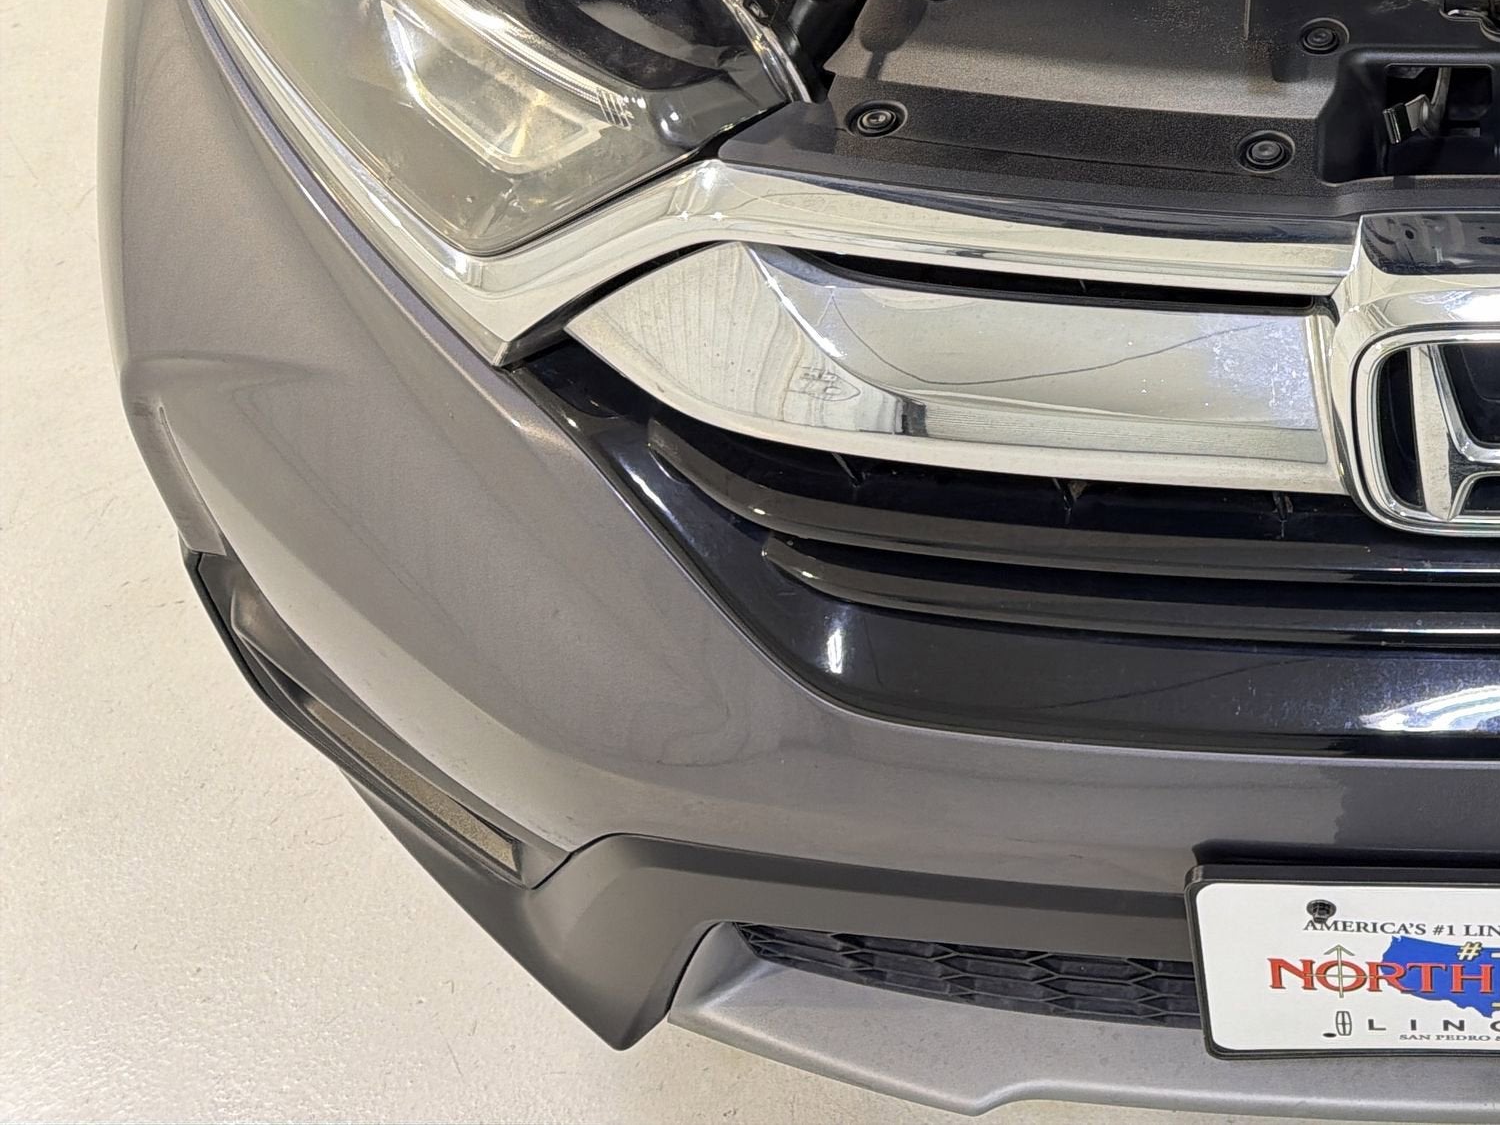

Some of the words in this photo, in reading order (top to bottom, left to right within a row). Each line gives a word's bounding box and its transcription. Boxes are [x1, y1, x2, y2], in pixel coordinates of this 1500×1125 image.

[1303, 920, 1427, 936] AMERICA'S
[1432, 924, 1456, 936] #1
[1267, 957, 1495, 994] NORTH
[1399, 1033, 1431, 1041] SAN
[1435, 1034, 1491, 1042] PEDRO
